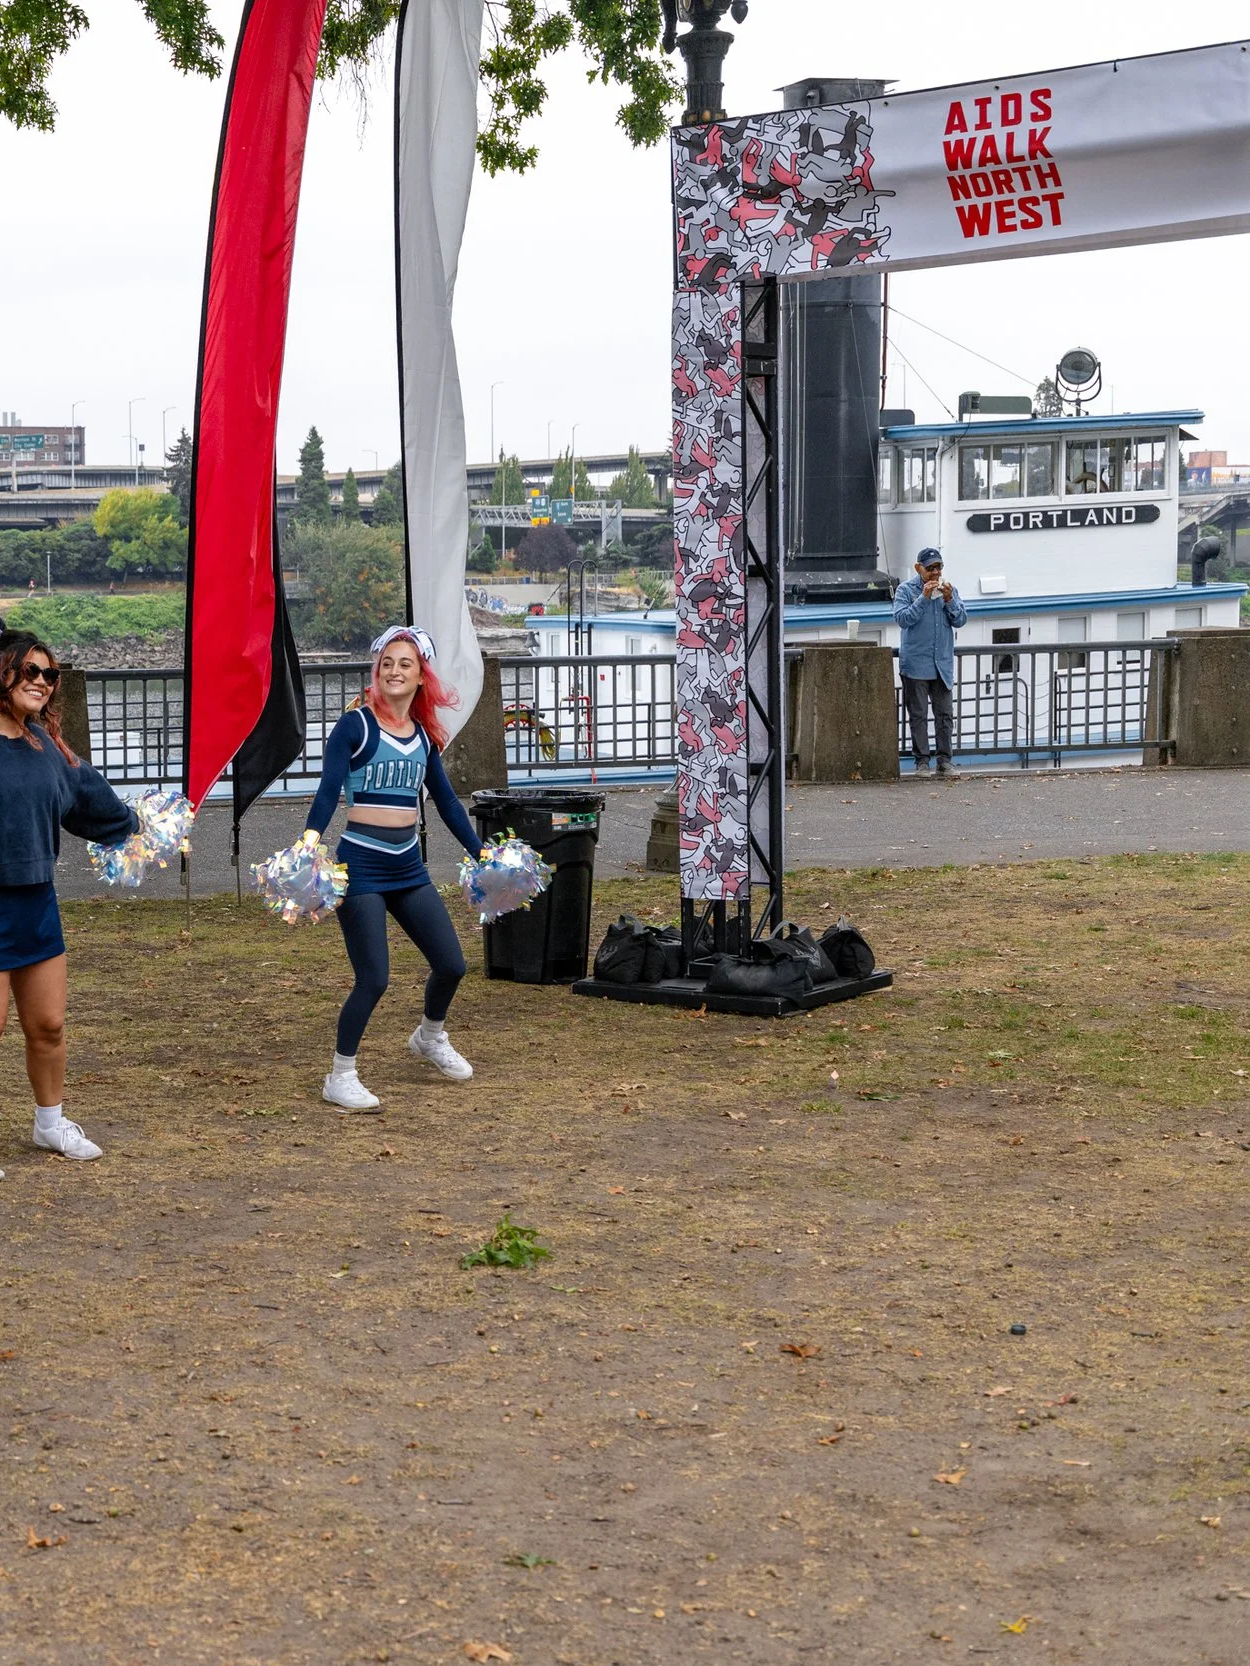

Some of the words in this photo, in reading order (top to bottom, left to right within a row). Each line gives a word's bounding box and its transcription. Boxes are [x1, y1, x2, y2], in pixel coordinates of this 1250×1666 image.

[944, 88, 1052, 135] AIDS
[942, 126, 1054, 172] WALK
[946, 162, 1063, 201] NORTH
[954, 192, 1065, 239] WEST
[990, 506, 1136, 531] PORTLAND
